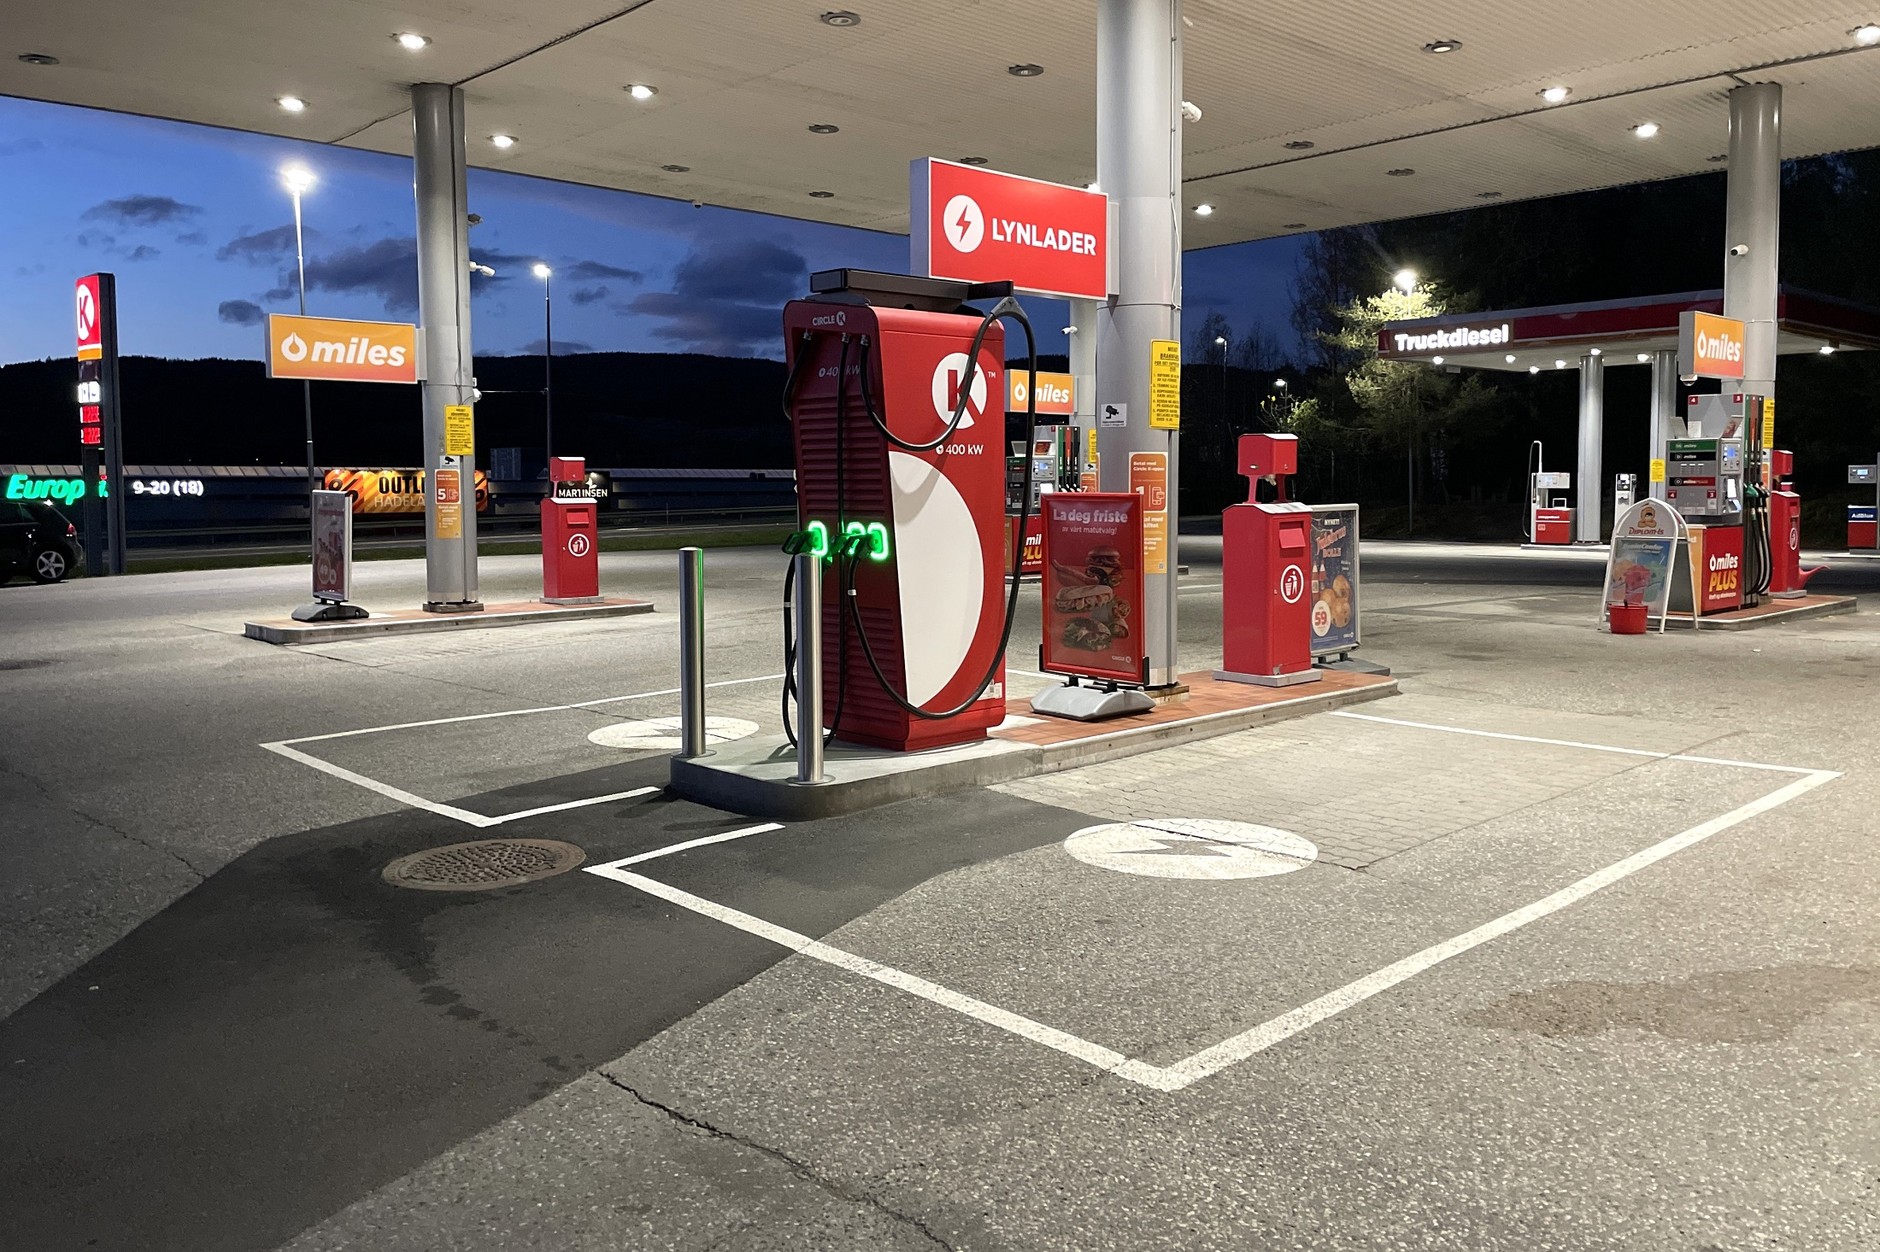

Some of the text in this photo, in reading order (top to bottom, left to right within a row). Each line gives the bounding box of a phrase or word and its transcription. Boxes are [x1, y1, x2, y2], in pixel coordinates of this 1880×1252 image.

[991, 217, 1097, 256] LYNLADER
[812, 311, 846, 327] CIRCLE K
[1394, 323, 1510, 352] Truckdiesel
[310, 336, 407, 367] miles
[1708, 333, 1741, 363] miles
[826, 366, 839, 377] 40
[945, 444, 984, 455] 400 kW
[132, 480, 205, 496] 9-20 (18)
[378, 475, 425, 494] OUTL
[437, 488, 446, 500] 5
[558, 488, 608, 498] MARTINSEN
[1053, 509, 1067, 521] La
[1067, 509, 1091, 524] deg
[1093, 510, 1129, 523] friste
[1083, 527, 1118, 536] matutvalg!
[1716, 552, 1739, 570] miles
[1709, 570, 1738, 592] PLUS
